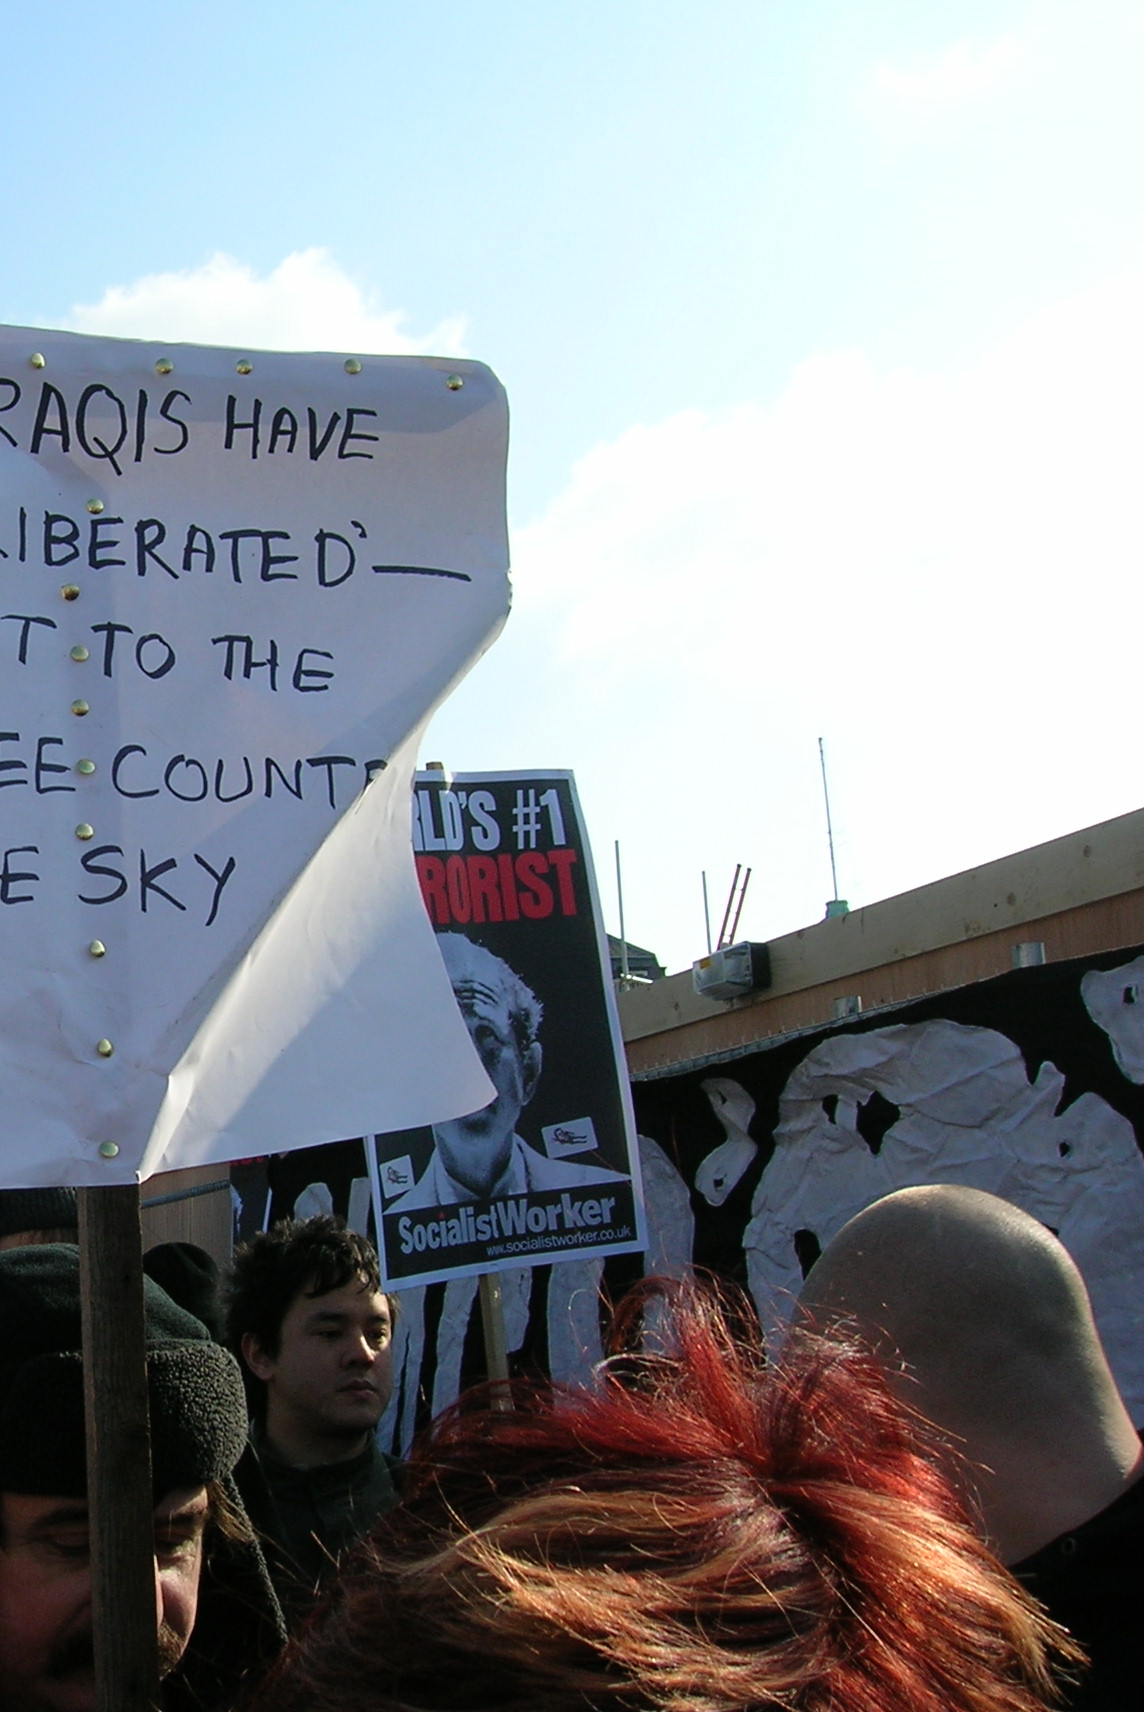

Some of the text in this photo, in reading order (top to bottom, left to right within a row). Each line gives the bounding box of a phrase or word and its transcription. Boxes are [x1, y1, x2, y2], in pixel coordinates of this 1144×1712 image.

[224, 394, 380, 461] HAVE
[90, 621, 176, 679] TO
[211, 634, 335, 693] THE
[512, 788, 567, 849] #1
[77, 845, 236, 926] SKY
